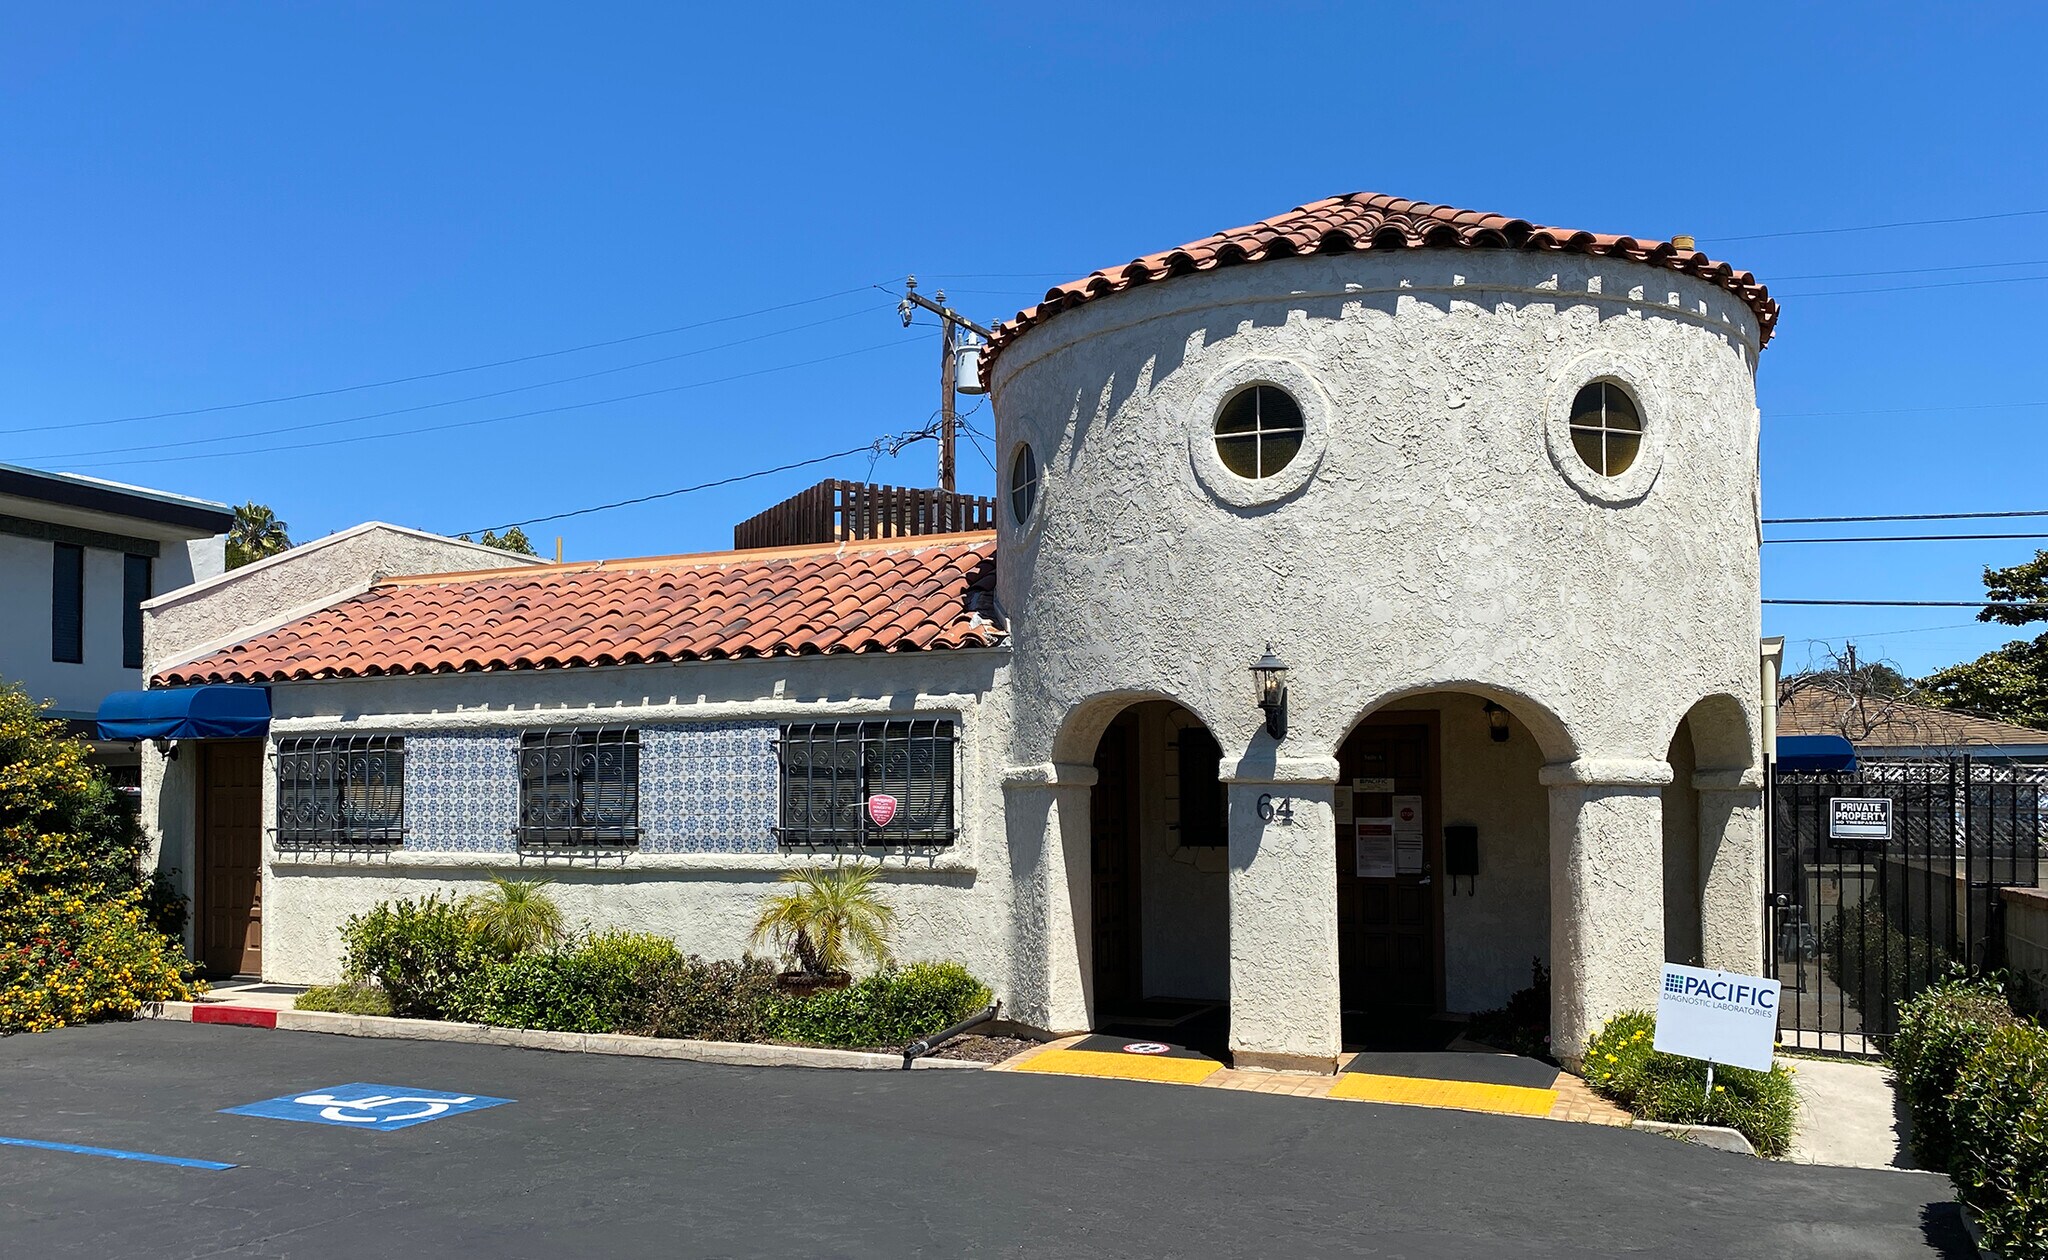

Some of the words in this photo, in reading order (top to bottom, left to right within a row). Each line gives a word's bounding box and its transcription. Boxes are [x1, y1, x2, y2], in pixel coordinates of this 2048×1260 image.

[1257, 793, 1294, 825] 64
[1835, 811, 1886, 821] PROPERTY
[1840, 803, 1881, 812] PRIVATE
[1685, 976, 1775, 1009] PACIFIC
[1663, 993, 1711, 1008] DIAGNOSTIC
[1712, 1001, 1773, 1019] LABORATORIES
